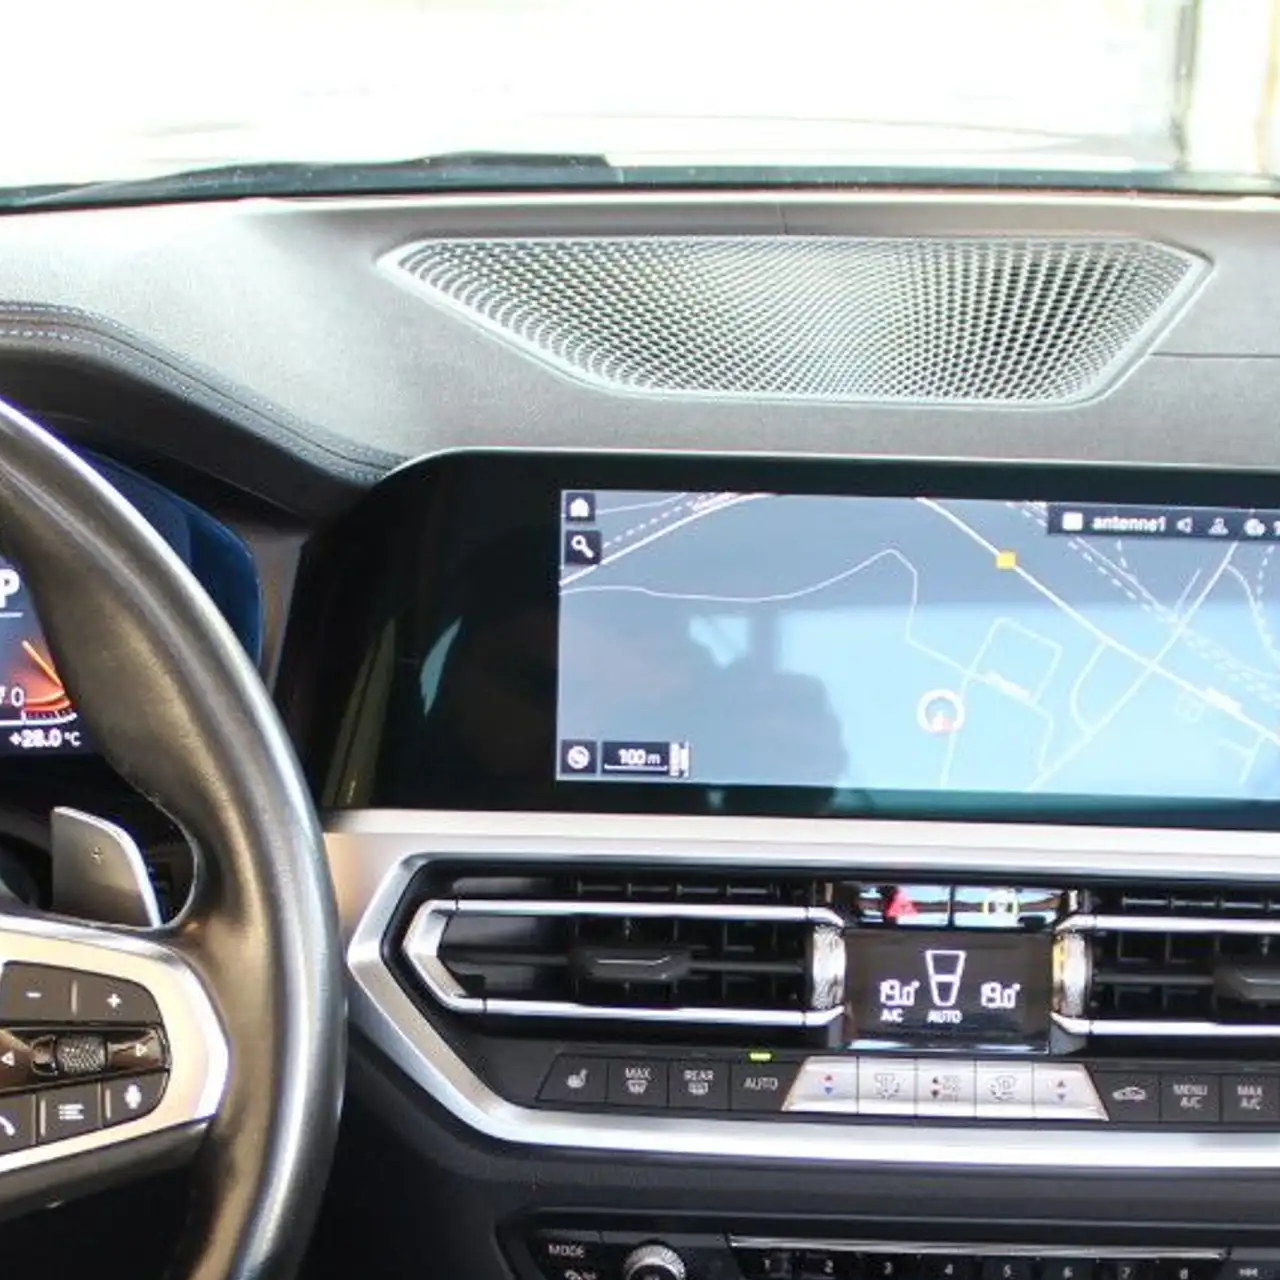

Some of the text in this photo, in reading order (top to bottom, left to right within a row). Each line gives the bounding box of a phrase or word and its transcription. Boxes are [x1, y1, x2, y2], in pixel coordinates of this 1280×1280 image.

[617, 749, 645, 765] 100
[927, 1008, 962, 1024] AUTO
[625, 1067, 651, 1079] MAX
[683, 1069, 715, 1081] REAR
[743, 1076, 779, 1091] AUTO
[1173, 1083, 1208, 1096] MENU
[548, 1243, 584, 1258] MODE
[824, 1259, 834, 1273] 2
